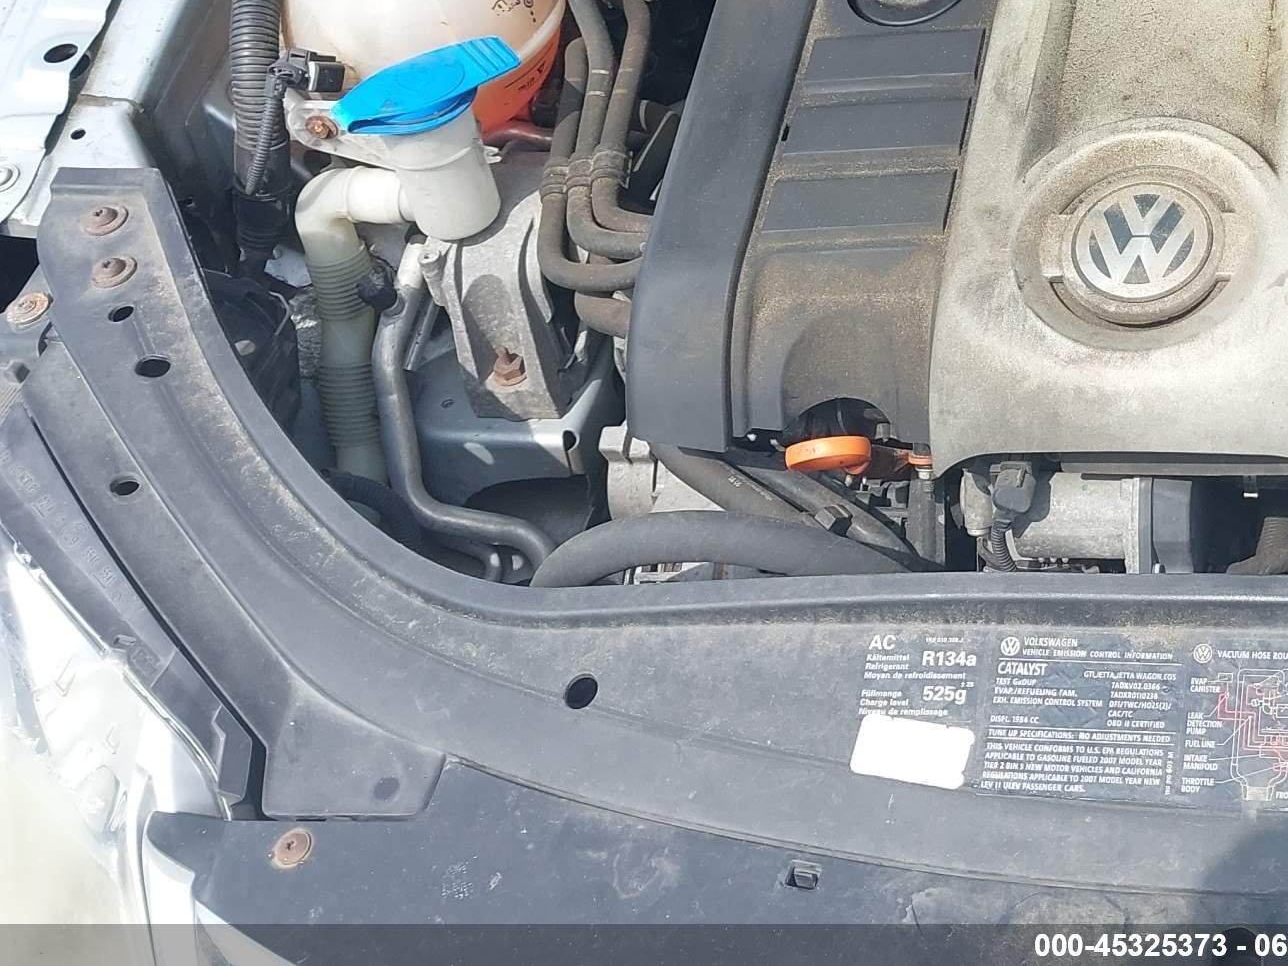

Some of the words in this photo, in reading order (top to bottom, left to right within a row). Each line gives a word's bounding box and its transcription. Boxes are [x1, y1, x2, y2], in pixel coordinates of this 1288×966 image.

[869, 634, 896, 650] AC
[1024, 637, 1077, 647] VOLKSWAGEN
[922, 650, 976, 666] R134a
[1218, 650, 1249, 658] VACUUM
[866, 663, 909, 671] Refrigerant
[998, 662, 1048, 676] CATALYST
[864, 672, 890, 680] Moyen
[862, 690, 902, 698] Füllmenge
[922, 686, 966, 705] 525g
[1010, 697, 1042, 705] EMISSION
[1045, 698, 1075, 706] CONTROL
[900, 708, 948, 716] remplissage
[1092, 733, 1141, 742] ADJUSTMENTS
[1004, 743, 1032, 751] VEHICLE
[1034, 744, 1073, 752] CONFORMS
[1116, 748, 1163, 756] REGULATIONS
[985, 752, 1024, 760] APPLICABLE
[1037, 754, 1072, 762] GASOLINE
[1073, 756, 1098, 764] FUELED
[1119, 757, 1143, 765] MODEL
[1071, 765, 1103, 773] VEHICLES
[1183, 762, 1218, 770] MANIFOLD
[1182, 778, 1215, 786] THROTTLE
[1022, 783, 1062, 791] PASSENGER
